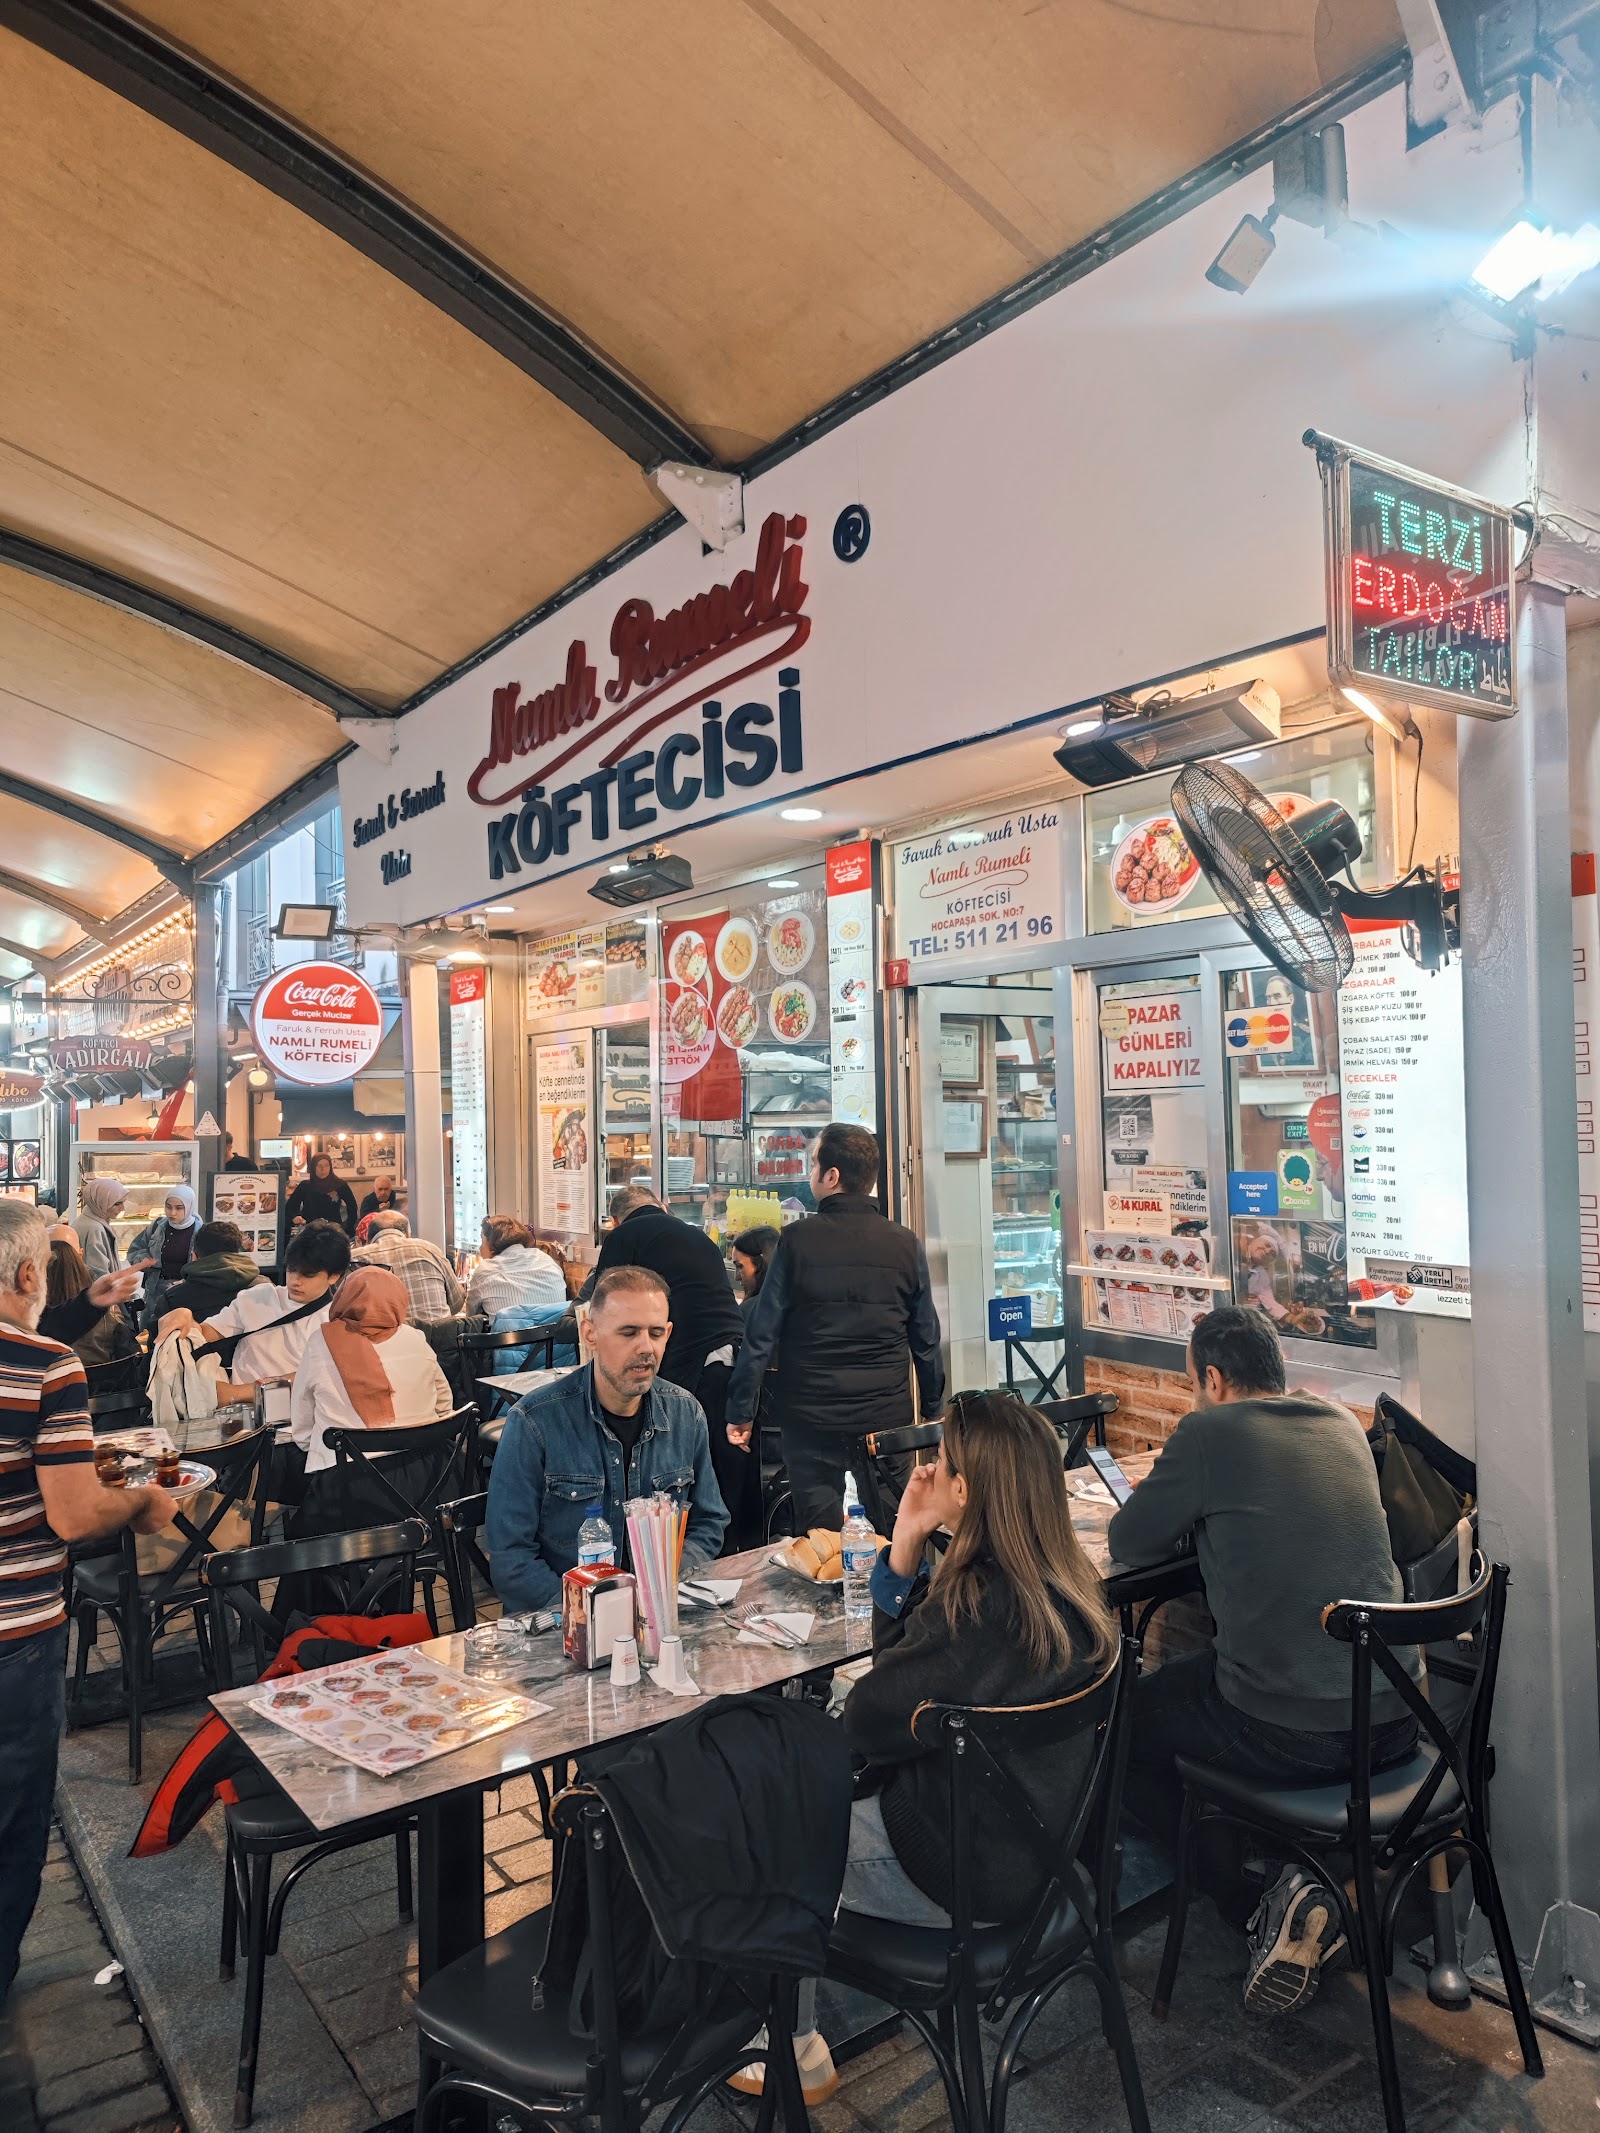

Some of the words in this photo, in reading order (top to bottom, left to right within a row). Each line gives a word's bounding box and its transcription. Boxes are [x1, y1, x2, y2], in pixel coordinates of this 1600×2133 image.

[1373, 491, 1482, 574] TERZİ
[1354, 558, 1505, 643] ERDOĞAN
[488, 640, 601, 768] Namlı
[605, 512, 809, 702] Rumeli
[1364, 626, 1476, 693] TAILOR
[487, 667, 803, 880] KÖFTECİSİ
[901, 838, 943, 865] Faruk
[1017, 813, 1058, 834] Usta
[926, 861, 970, 885] Namlı
[974, 847, 1032, 876] Rumeli
[946, 887, 1011, 914] KÖFTECİSİ
[931, 914, 977, 932] HOCAPAŞA
[979, 910, 1000, 922] SOK.
[1003, 906, 1025, 917] NO:7
[909, 937, 949, 957] TEL:
[954, 926, 987, 950] 511
[995, 921, 1018, 943] 21
[1027, 915, 1053, 938] 96
[1353, 938, 1392, 950] RBALAR
[1353, 953, 1380, 963] CİMEK
[893, 966, 899, 980] 7
[1350, 967, 1364, 975] YLA
[1367, 965, 1378, 973] 200
[1343, 977, 1395, 989] ZGARALAR
[284, 981, 361, 1008] Coca-Cola
[1370, 991, 1395, 999] KÖFTE
[292, 1009, 321, 1019] Gerçek
[323, 1010, 352, 1019] Mucize
[1128, 1004, 1181, 1025] PAZAR
[1342, 1005, 1353, 1014] ŞİŞ
[1355, 1004, 1379, 1012] KEBAP
[1342, 1017, 1353, 1025] ŞİŞ
[1382, 1014, 1407, 1022] TAVUK
[277, 1024, 303, 1033] Faruk
[305, 1025, 312, 1034] &
[314, 1026, 343, 1035] Ferruh
[346, 1027, 366, 1037] Usta
[82, 1037, 119, 1049] KÖFTECİ
[270, 1036, 316, 1048] NAMLI
[320, 1038, 372, 1050] RUMELİ
[1119, 1026, 1192, 1052] GÜNLERİ
[1342, 1037, 1368, 1045] ÇOBAN
[284, 1050, 357, 1063] KÖFTECİSİ
[1343, 1047, 1364, 1055] PİYAZ
[1366, 1046, 1391, 1055] (SADE)
[1405, 1046, 1412, 1054] gr
[50, 1049, 152, 1072] KADIRGALI
[1343, 1058, 1364, 1067] İRMİK
[1366, 1058, 1398, 1066] HELVASI
[1113, 1058, 1201, 1080] KAPALIYIZ
[539, 1075, 553, 1087] Köfte
[555, 1073, 585, 1086] cennetinde
[1344, 1072, 1397, 1084] İÇECEKLER
[547, 1088, 586, 1103] beğendiklerim
[1349, 1144, 1372, 1154] Sprite
[1239, 1183, 1268, 1191] Accepted
[1168, 1191, 1206, 1202] nnetinde
[1246, 1190, 1261, 1198] here
[1351, 1192, 1376, 1201] damla
[1120, 1201, 1130, 1211] 14
[1131, 1200, 1163, 1212] KURAL
[1170, 1201, 1207, 1213] ndiklerim
[1289, 1197, 1311, 1205] bonus
[1352, 1209, 1377, 1218] damla
[1350, 1231, 1376, 1239] AYRAN
[1308, 1242, 1317, 1252] EN
[1351, 1246, 1381, 1256] YOĞURT
[1383, 1248, 1410, 1259] GÜVEÇ
[1423, 1269, 1444, 1277] YERLİ
[1424, 1277, 1450, 1285] ÜRETİM
[1437, 1294, 1464, 1304] lezzeti
[1000, 1311, 1023, 1322] Open
